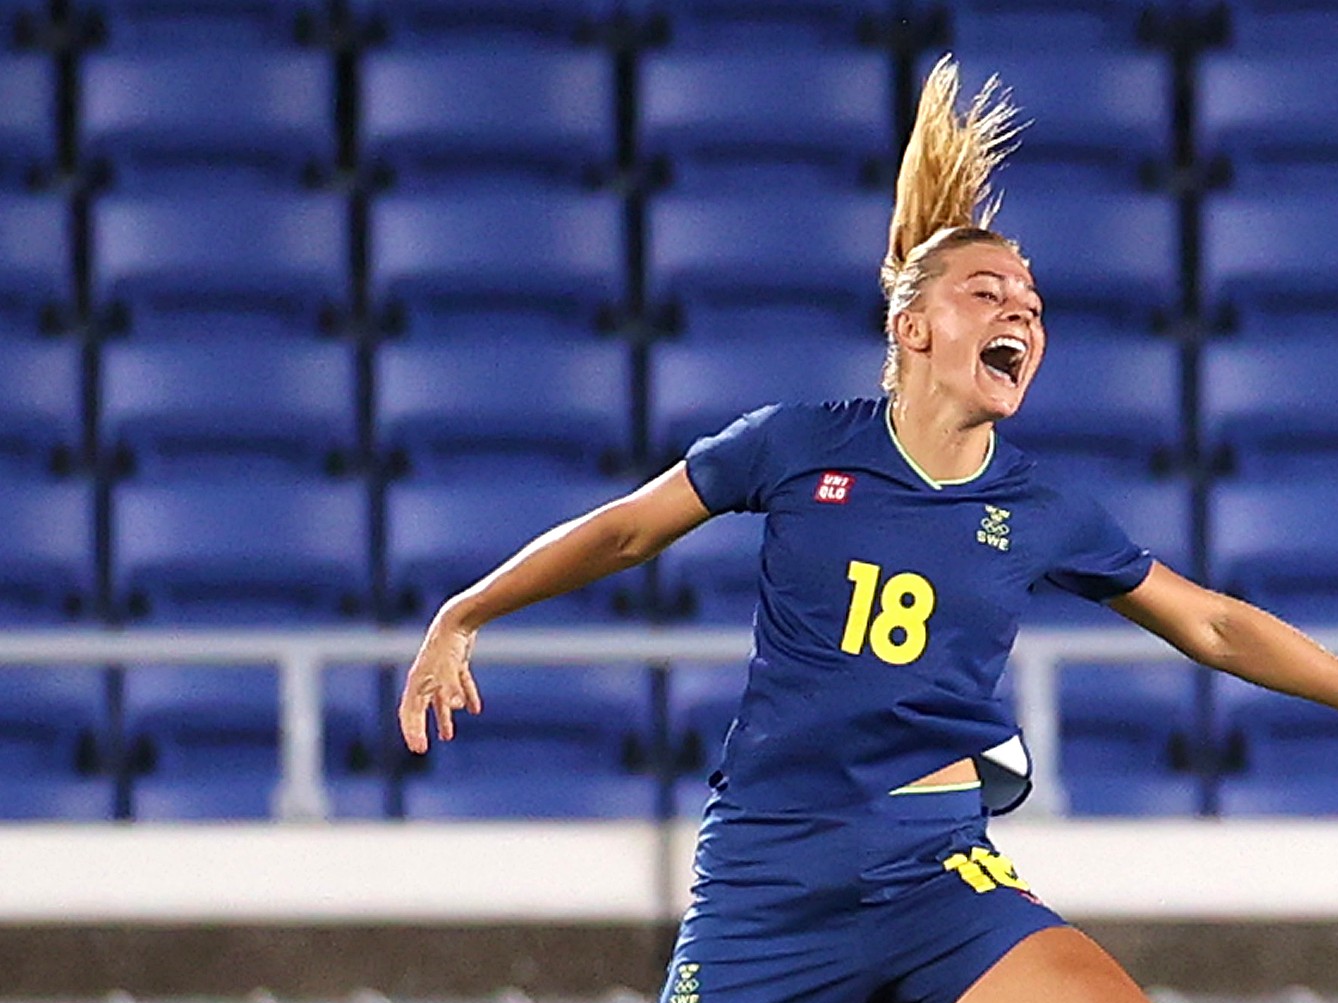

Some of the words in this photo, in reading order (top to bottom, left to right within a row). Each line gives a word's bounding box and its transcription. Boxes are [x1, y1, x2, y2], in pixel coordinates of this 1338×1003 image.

[823, 474, 849, 486] UNI
[977, 531, 1009, 551] SWE
[840, 560, 936, 665] 18
